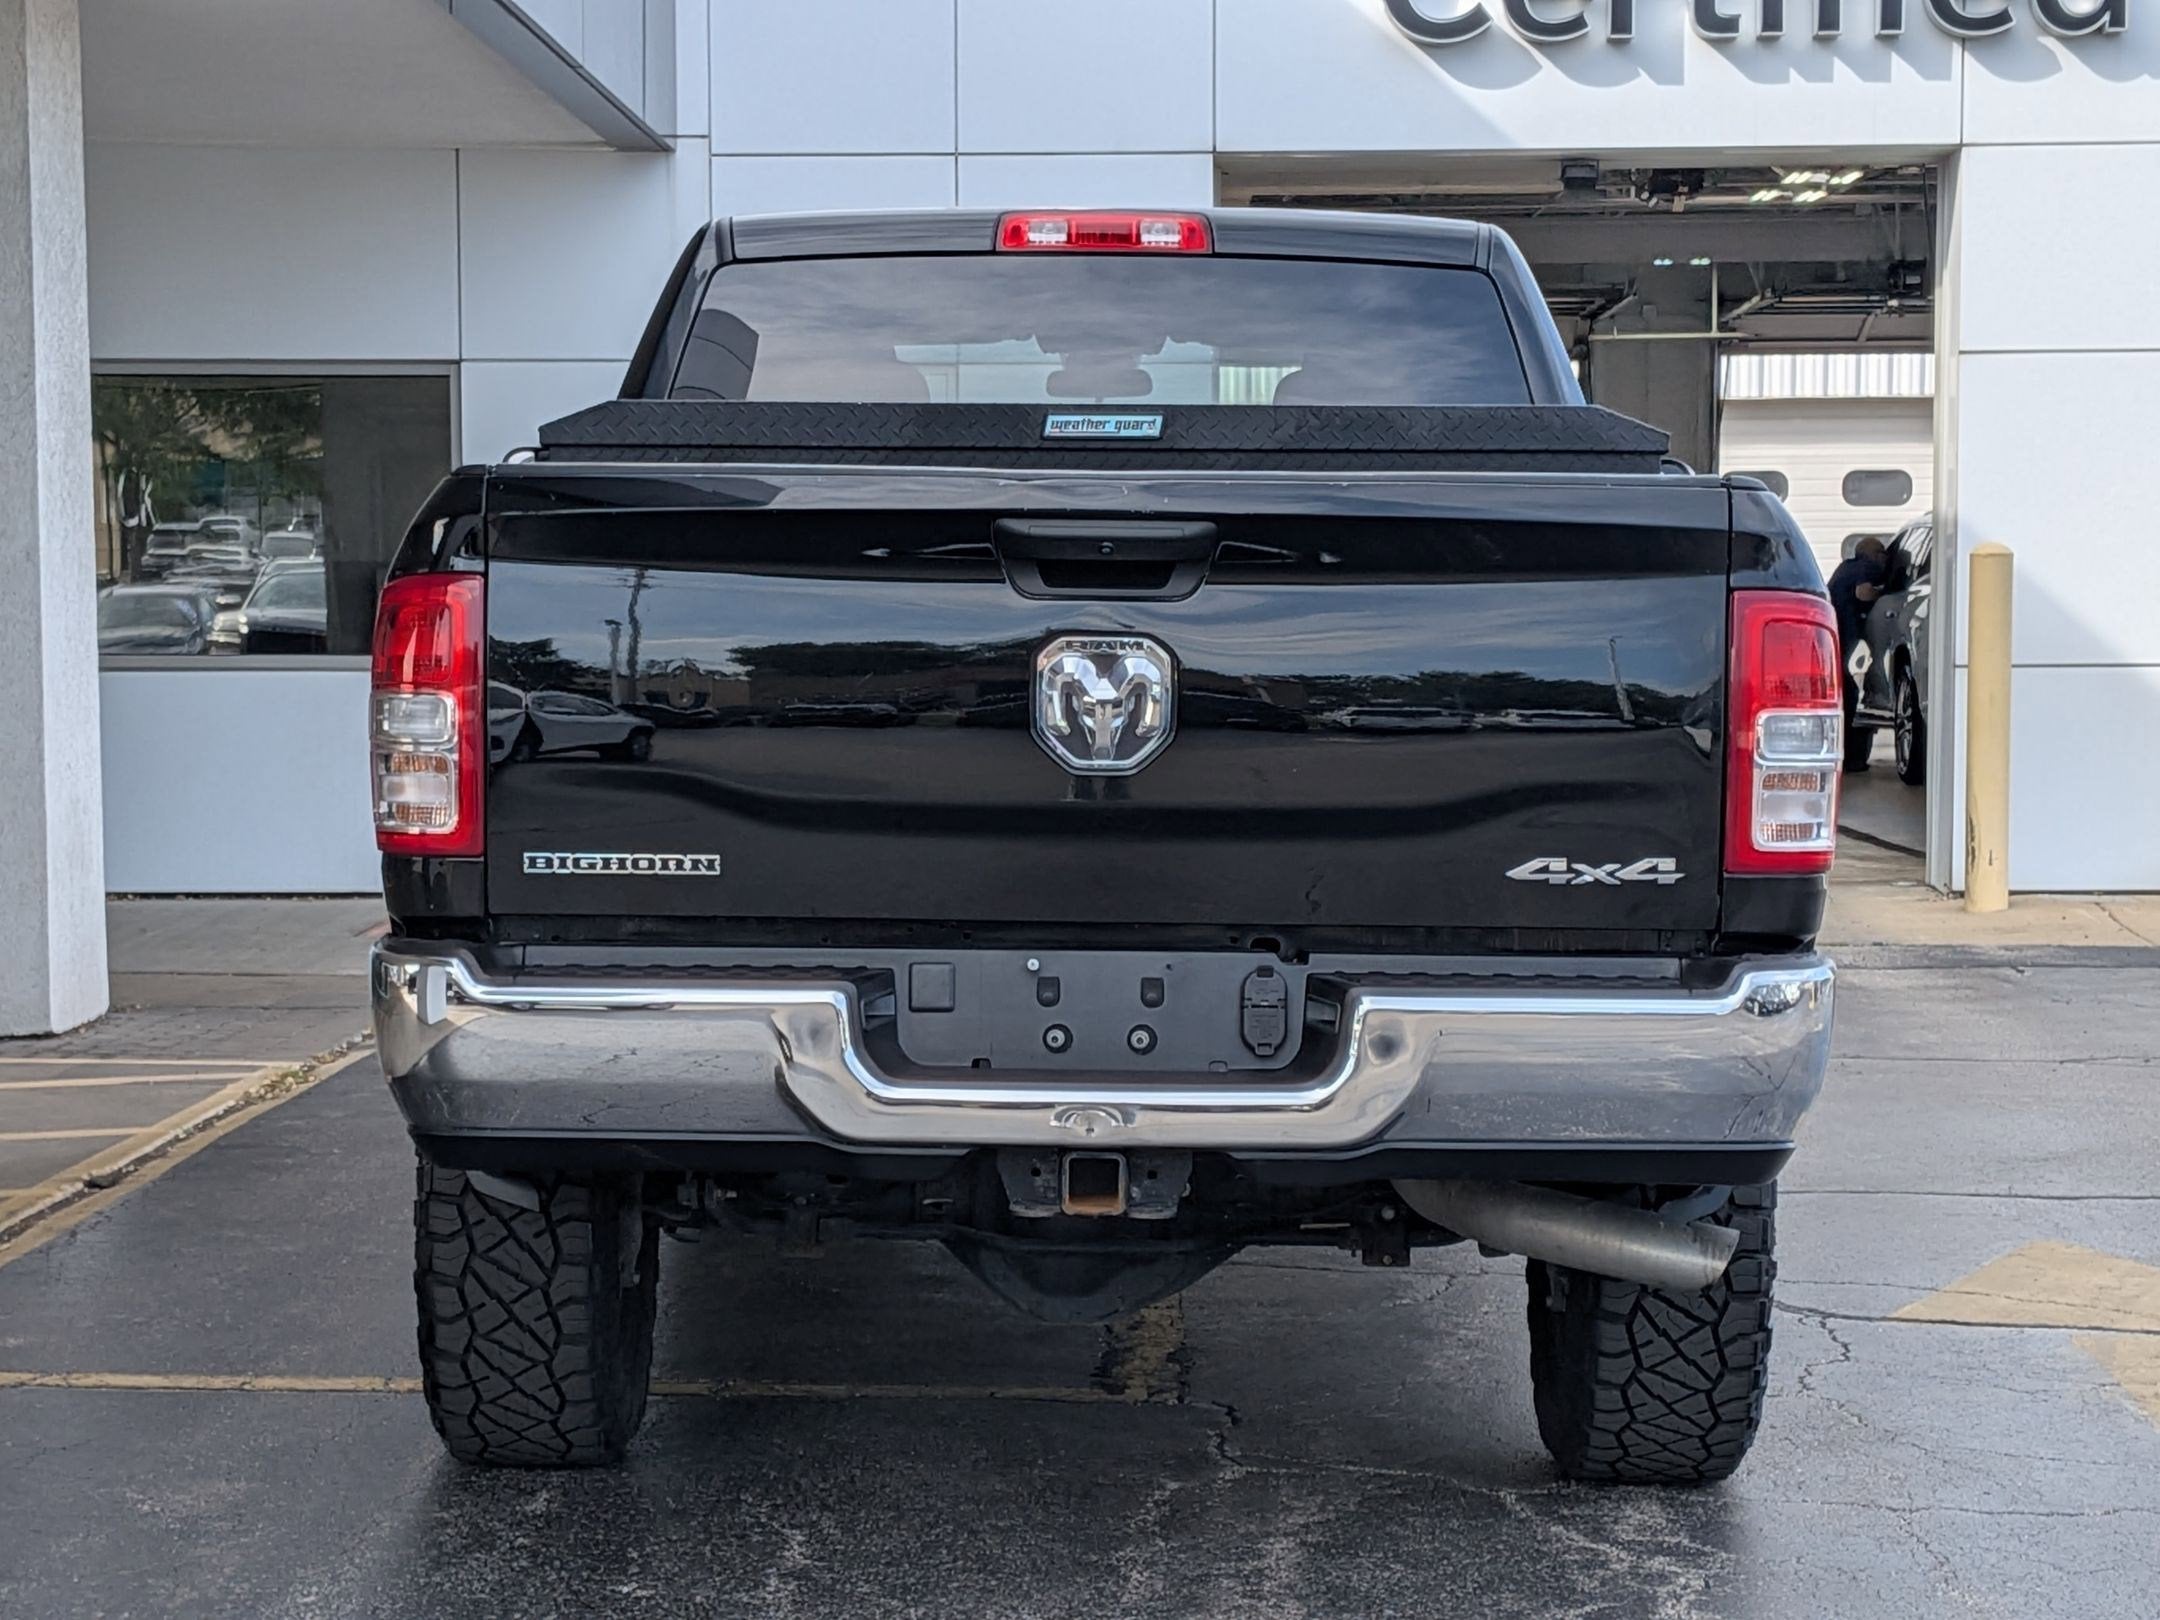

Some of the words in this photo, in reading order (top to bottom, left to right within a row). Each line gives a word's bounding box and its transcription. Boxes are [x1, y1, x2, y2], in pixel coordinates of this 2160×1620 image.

[1050, 418, 1111, 432] weather
[1114, 418, 1157, 433] guard
[1063, 639, 1146, 652] RAM
[523, 852, 721, 875] BIGHORN
